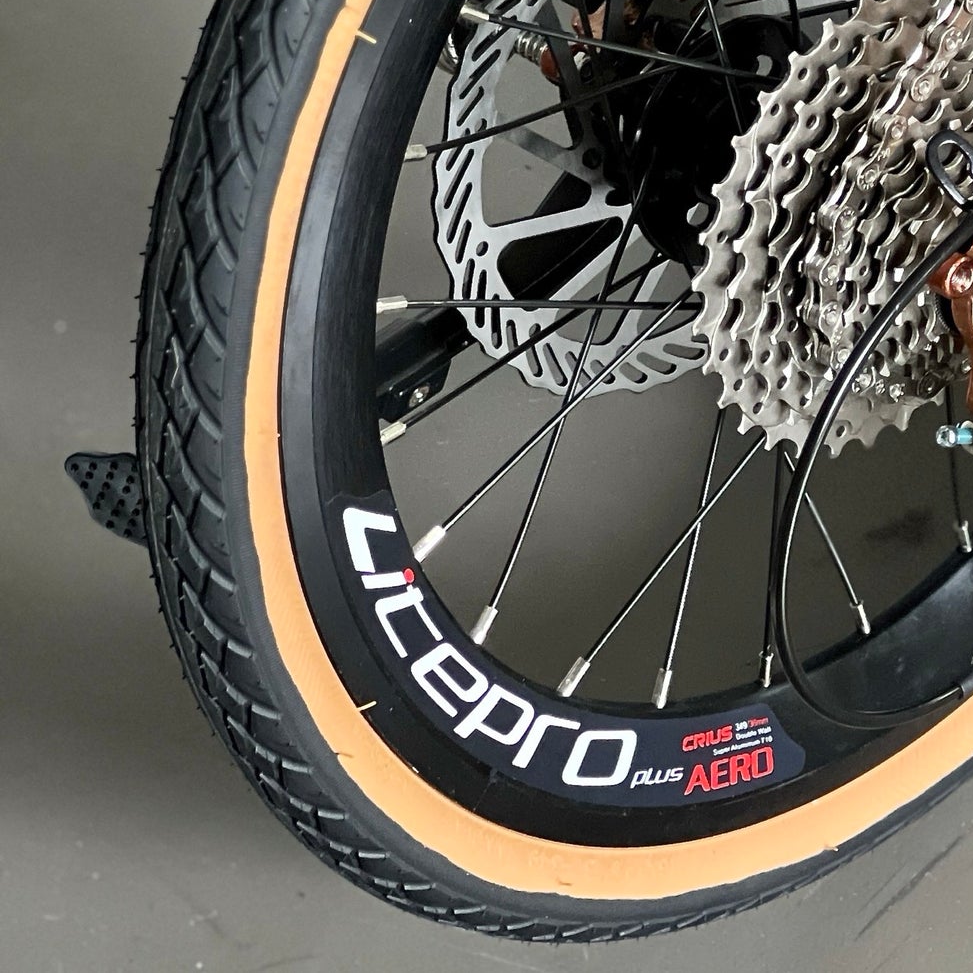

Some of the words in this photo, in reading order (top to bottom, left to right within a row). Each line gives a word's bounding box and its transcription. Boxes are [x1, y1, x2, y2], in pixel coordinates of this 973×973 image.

[682, 724, 733, 752] CRIUS
[630, 767, 684, 789] plus
[684, 746, 774, 796] AERO
